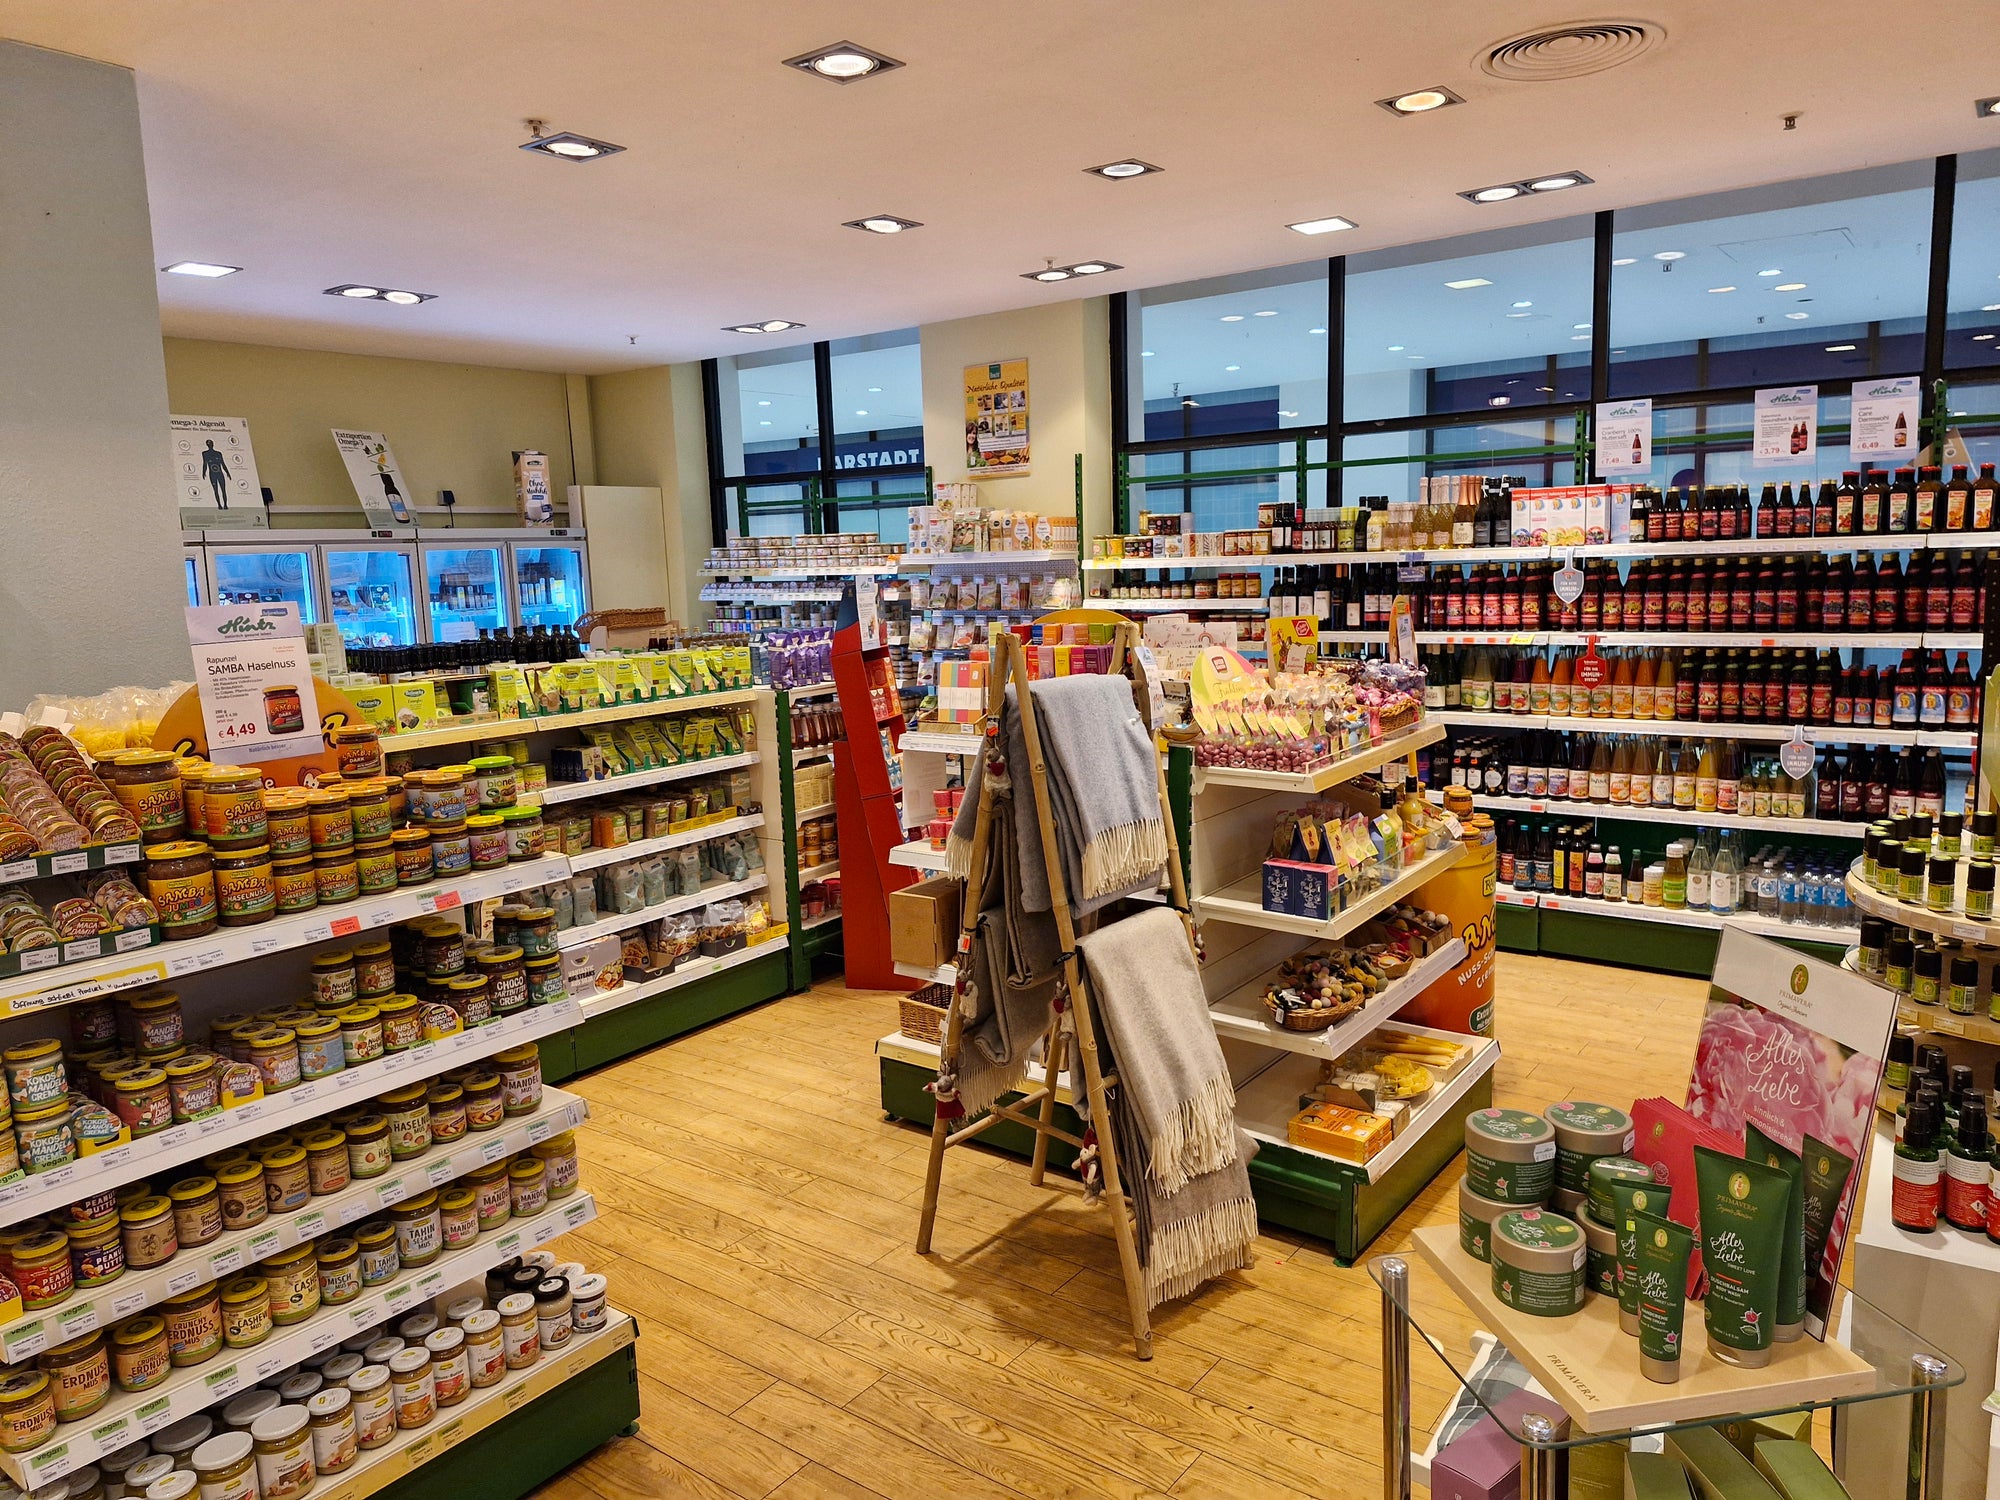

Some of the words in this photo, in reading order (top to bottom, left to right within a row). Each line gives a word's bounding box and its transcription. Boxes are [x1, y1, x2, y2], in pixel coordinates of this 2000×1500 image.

[818, 449, 919, 471] ARSTADT
[207, 655, 237, 664] Rapunzel
[208, 665, 244, 676] SAMBA
[248, 659, 296, 672] Haselnuss
[226, 723, 256, 737] 4,49
[342, 750, 371, 760] SAMBA
[138, 790, 181, 812] SAMBA
[103, 825, 124, 835] NUSS
[271, 826, 304, 839] SAMBA
[221, 878, 267, 896] SAMBA
[158, 885, 205, 906] SAMBA
[228, 888, 267, 902] HASELNUSS
[168, 898, 203, 912] JUMBO
[60, 906, 84, 920] MACA
[497, 976, 524, 991] CHOCO
[330, 987, 352, 997] CREME
[467, 1000, 488, 1011] CHOCO
[499, 994, 525, 1006] CREME
[428, 1013, 447, 1022] CHOCO
[146, 1025, 181, 1037] MANDEL
[392, 1023, 412, 1032] NUSS
[149, 1033, 175, 1044] CREME
[395, 1035, 417, 1044] CREME
[413, 1040, 432, 1048] vegan
[1746, 1027, 1805, 1074] Alles
[26, 1072, 56, 1086] KOKOS
[228, 1075, 256, 1084] MANDEL
[508, 1076, 539, 1089] MANDEL
[1747, 1060, 1801, 1105] Liebe
[28, 1079, 63, 1095] MANDEL
[229, 1082, 250, 1091] CREME
[520, 1086, 532, 1094] MUS
[31, 1087, 60, 1101] CREME
[183, 1090, 214, 1103] MANDEL
[150, 1099, 169, 1111] MACA
[185, 1099, 212, 1110] CREME
[195, 1107, 218, 1118] vegan
[1753, 1105, 1779, 1125] sinnlich
[1780, 1119, 1785, 1127] &
[83, 1122, 113, 1131] MANDEL
[413, 1126, 425, 1134] MUS
[1742, 1111, 1792, 1144] harmonisierend
[29, 1134, 60, 1148] KOKOS
[31, 1141, 67, 1158] MANDEL
[41, 1156, 68, 1167] vegan
[520, 1190, 546, 1202] MANDEL
[409, 1223, 435, 1239] TAHIN
[450, 1220, 476, 1233] MANDEL
[251, 1232, 273, 1243] vegan
[413, 1234, 433, 1245] SESAM
[1710, 1230, 1745, 1250] Alles
[418, 1241, 431, 1250] MUS
[213, 1247, 235, 1260] vegan
[1714, 1244, 1745, 1264] Liebe
[328, 1274, 352, 1286] MISCH
[1639, 1270, 1668, 1288] Alles
[1710, 1276, 1749, 1294] DUSCHBALSAM
[1642, 1282, 1669, 1299] Liebe
[62, 1302, 88, 1317] vegan
[173, 1316, 207, 1330] CRUNCHY
[237, 1312, 268, 1328] CASHEW
[250, 1322, 262, 1331] MUS
[11, 1321, 37, 1335] vegan
[168, 1320, 214, 1341] ERDNUSS
[184, 1336, 200, 1346] MUS
[131, 1354, 168, 1376] ERDNUSS
[62, 1359, 107, 1389] ERDNUSS
[146, 1369, 159, 1379] MUS
[210, 1367, 233, 1380] vegan
[1547, 1354, 1596, 1400] PRIMAVERA
[83, 1378, 99, 1390] MUS
[141, 1398, 164, 1412] vegan
[12, 1408, 53, 1432] ERDNUSS
[29, 1423, 44, 1434] MUS
[98, 1420, 123, 1434] vegan
[37, 1446, 63, 1460] vegan
